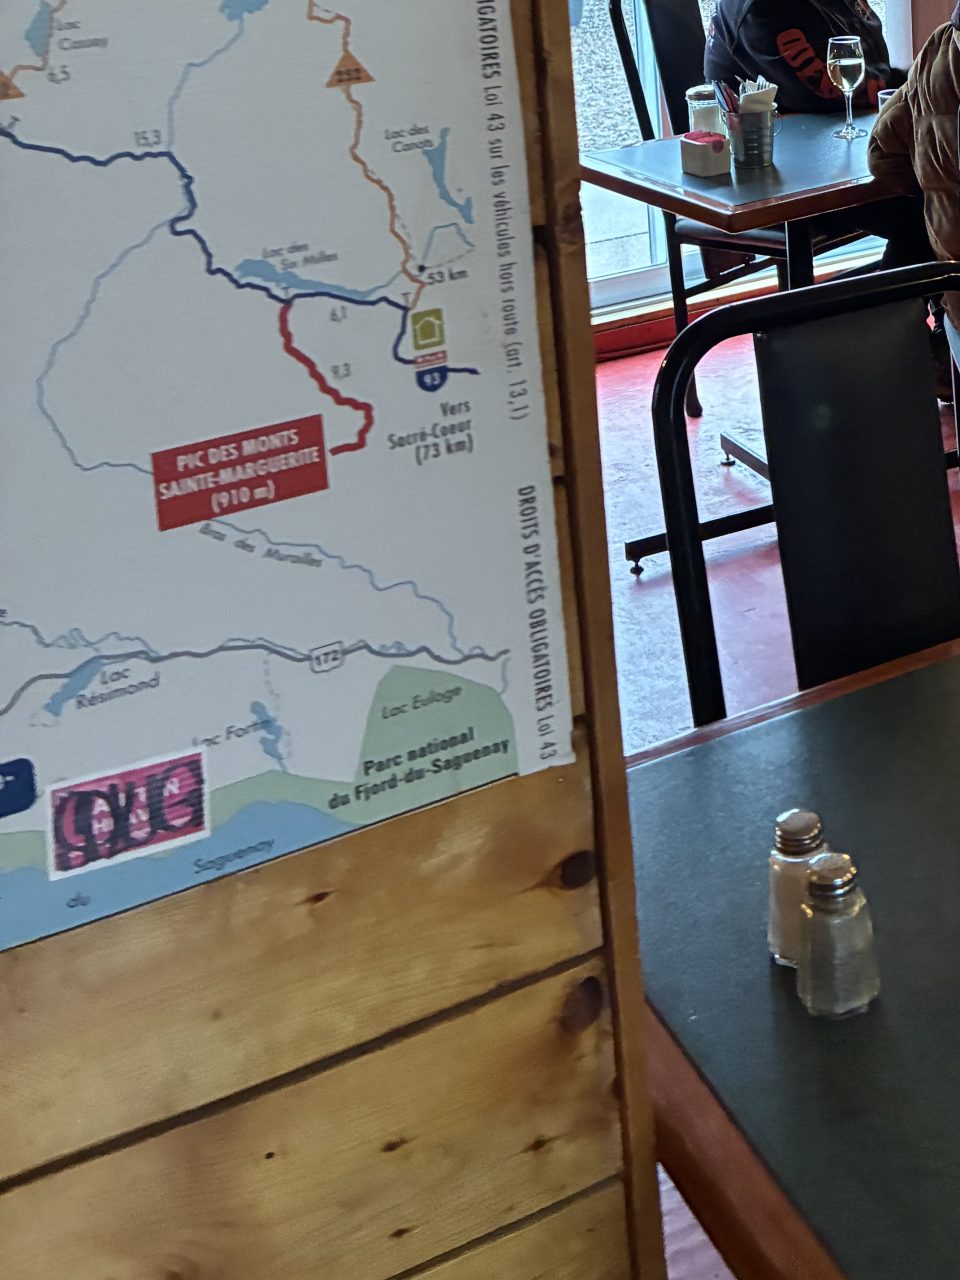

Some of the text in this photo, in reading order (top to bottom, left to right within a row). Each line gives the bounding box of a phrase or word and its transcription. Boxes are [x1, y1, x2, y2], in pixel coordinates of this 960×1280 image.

[483, 85, 503, 106] Loi
[486, 113, 505, 132] 43
[488, 139, 503, 159] sur
[490, 165, 510, 186] les
[493, 192, 516, 257] véhicules
[427, 267, 468, 285] 53 km
[499, 262, 518, 293] hors
[501, 299, 520, 336] route
[423, 373, 442, 386] 93
[440, 400, 472, 417] Vers
[387, 418, 472, 451] Sacré-Coeur
[414, 432, 474, 466] (73 km)
[176, 429, 299, 472] PIC DES MONTS
[159, 446, 320, 500] SAINTE-MARGUERITE
[210, 486, 250, 513] (910
[518, 485, 558, 761] DROITS D'ACCÈS OBLIGATOIRES Loi 43
[314, 650, 339, 666] 172
[100, 668, 130, 685] Lac
[381, 686, 463, 720] Lac Euloge
[363, 726, 474, 776] Parc national
[328, 738, 510, 809] du Fjord-du-Saguenay
